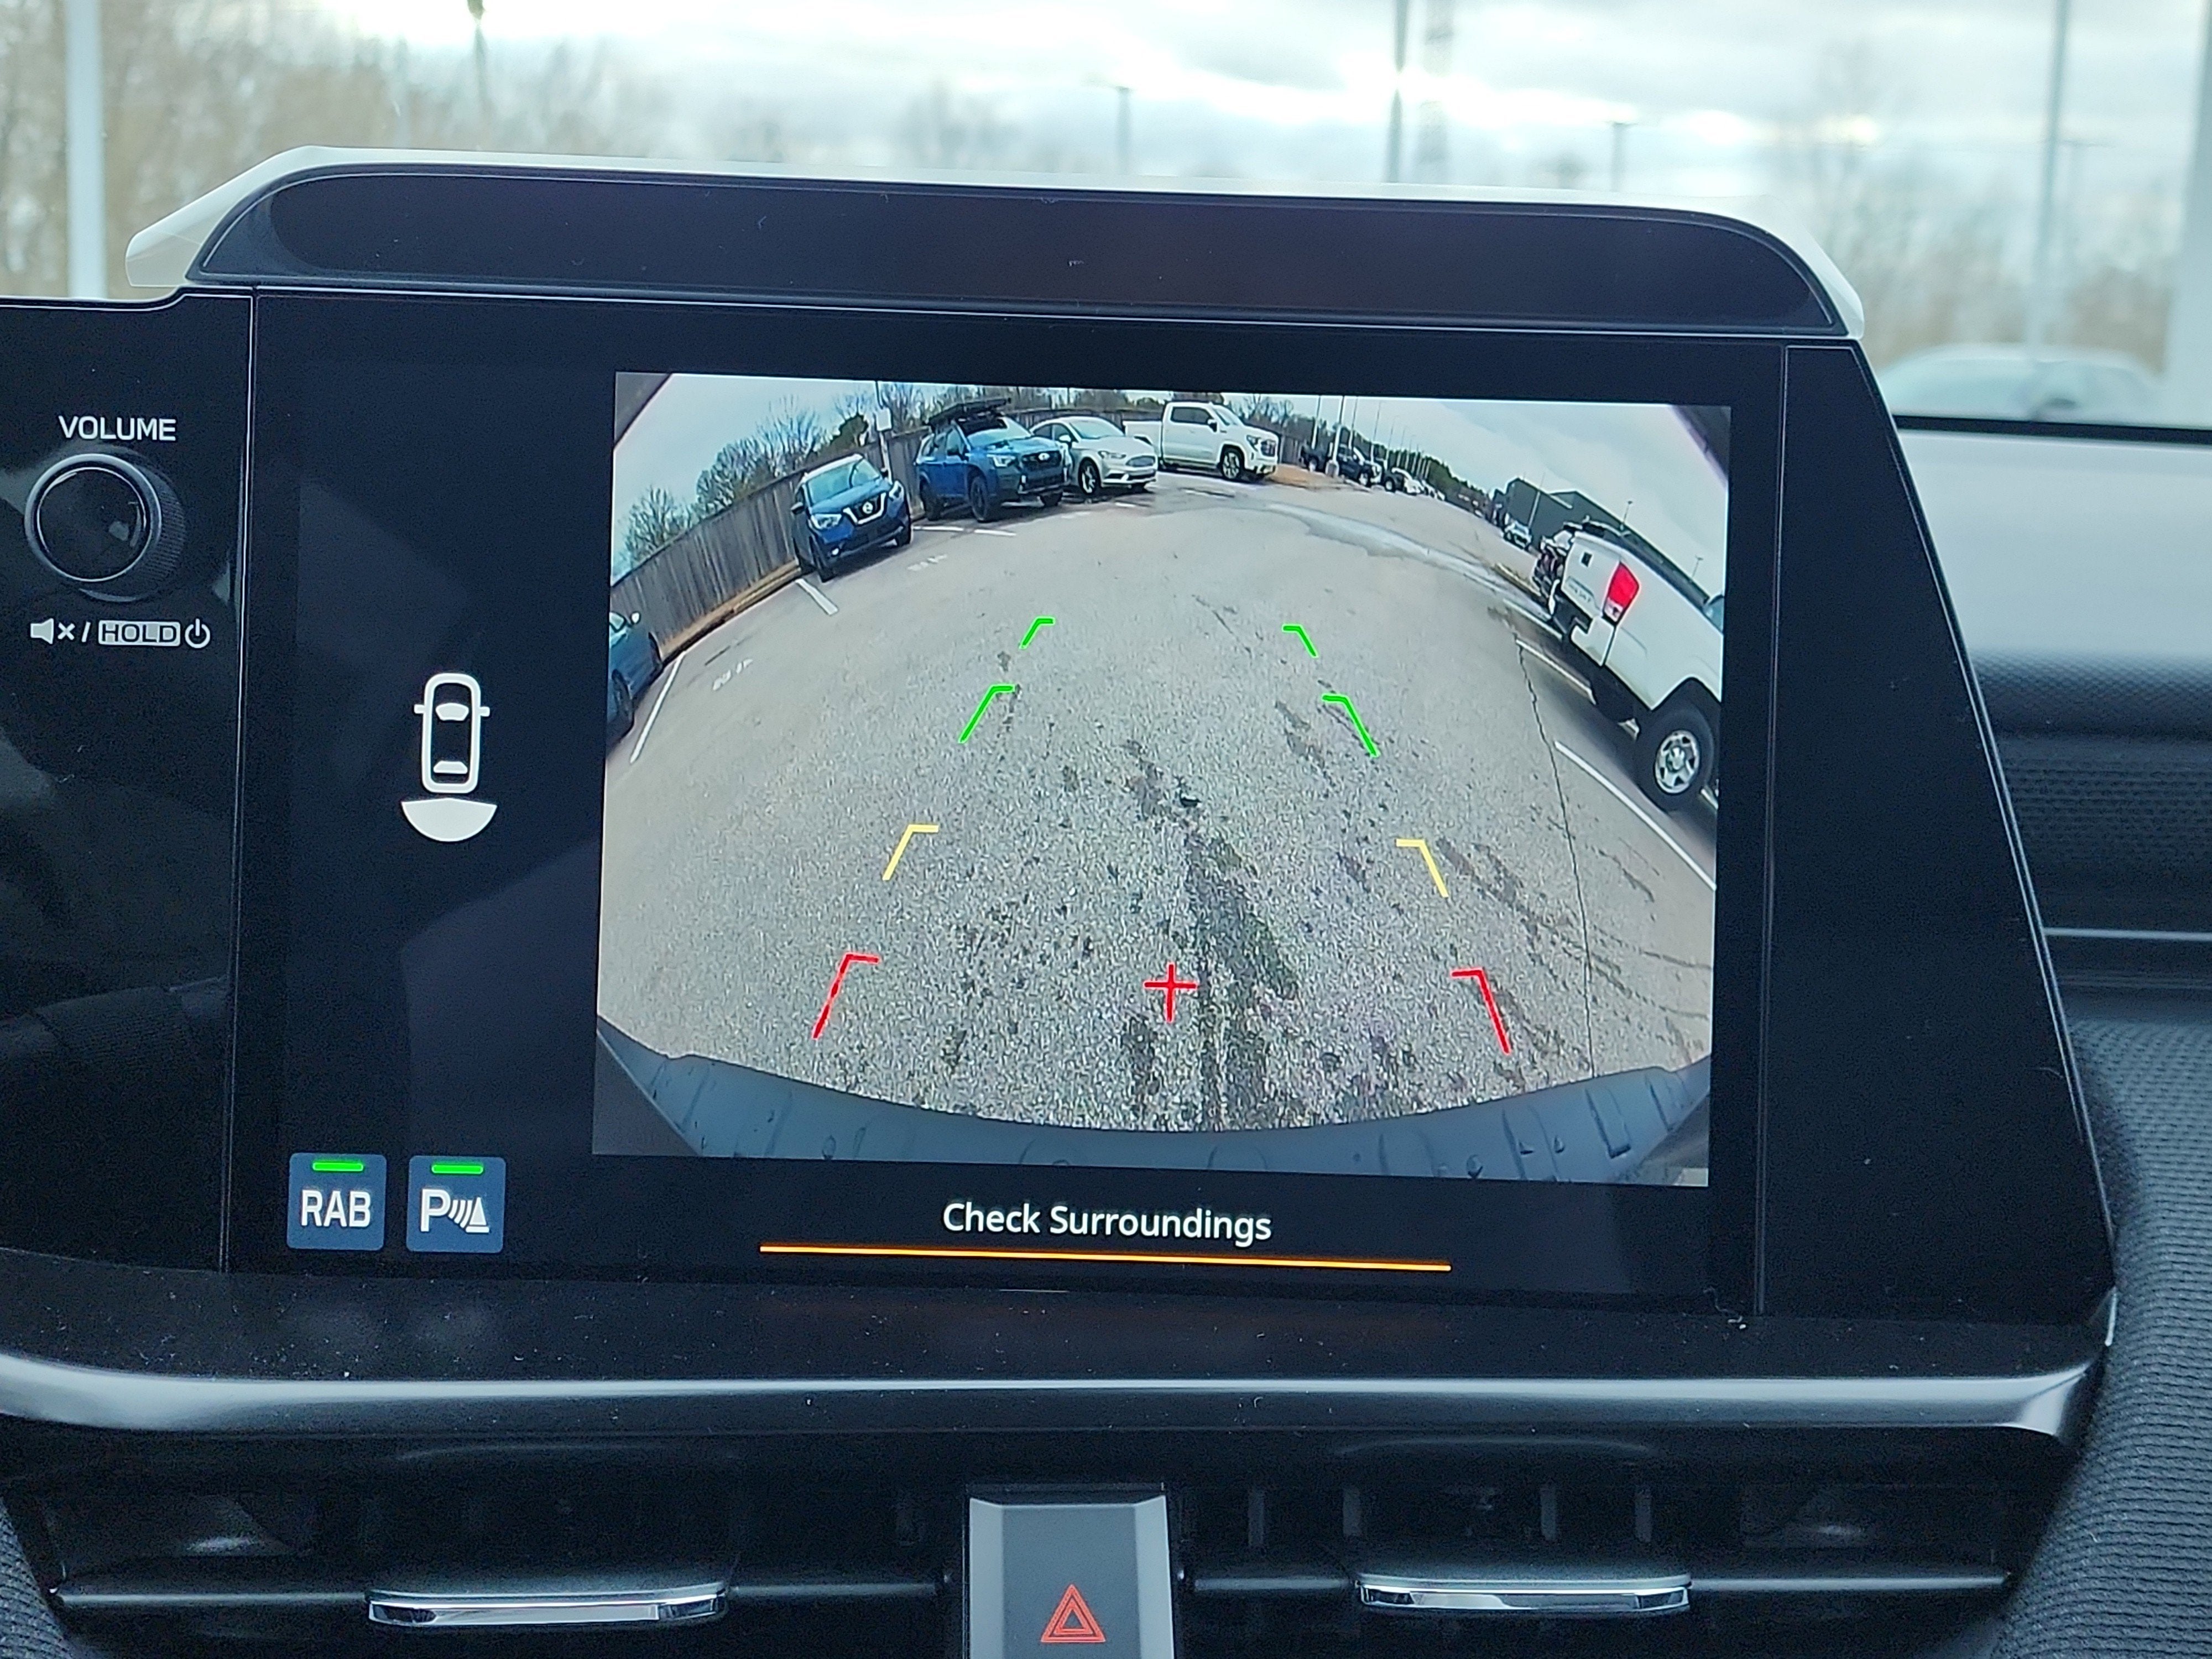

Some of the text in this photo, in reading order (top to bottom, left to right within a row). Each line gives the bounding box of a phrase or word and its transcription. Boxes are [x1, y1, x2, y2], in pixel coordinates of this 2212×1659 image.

[58, 415, 176, 441] VOLUME
[101, 623, 178, 642] HOLD
[301, 1189, 372, 1228] RAB
[943, 1202, 1272, 1248] Check Surroundings
